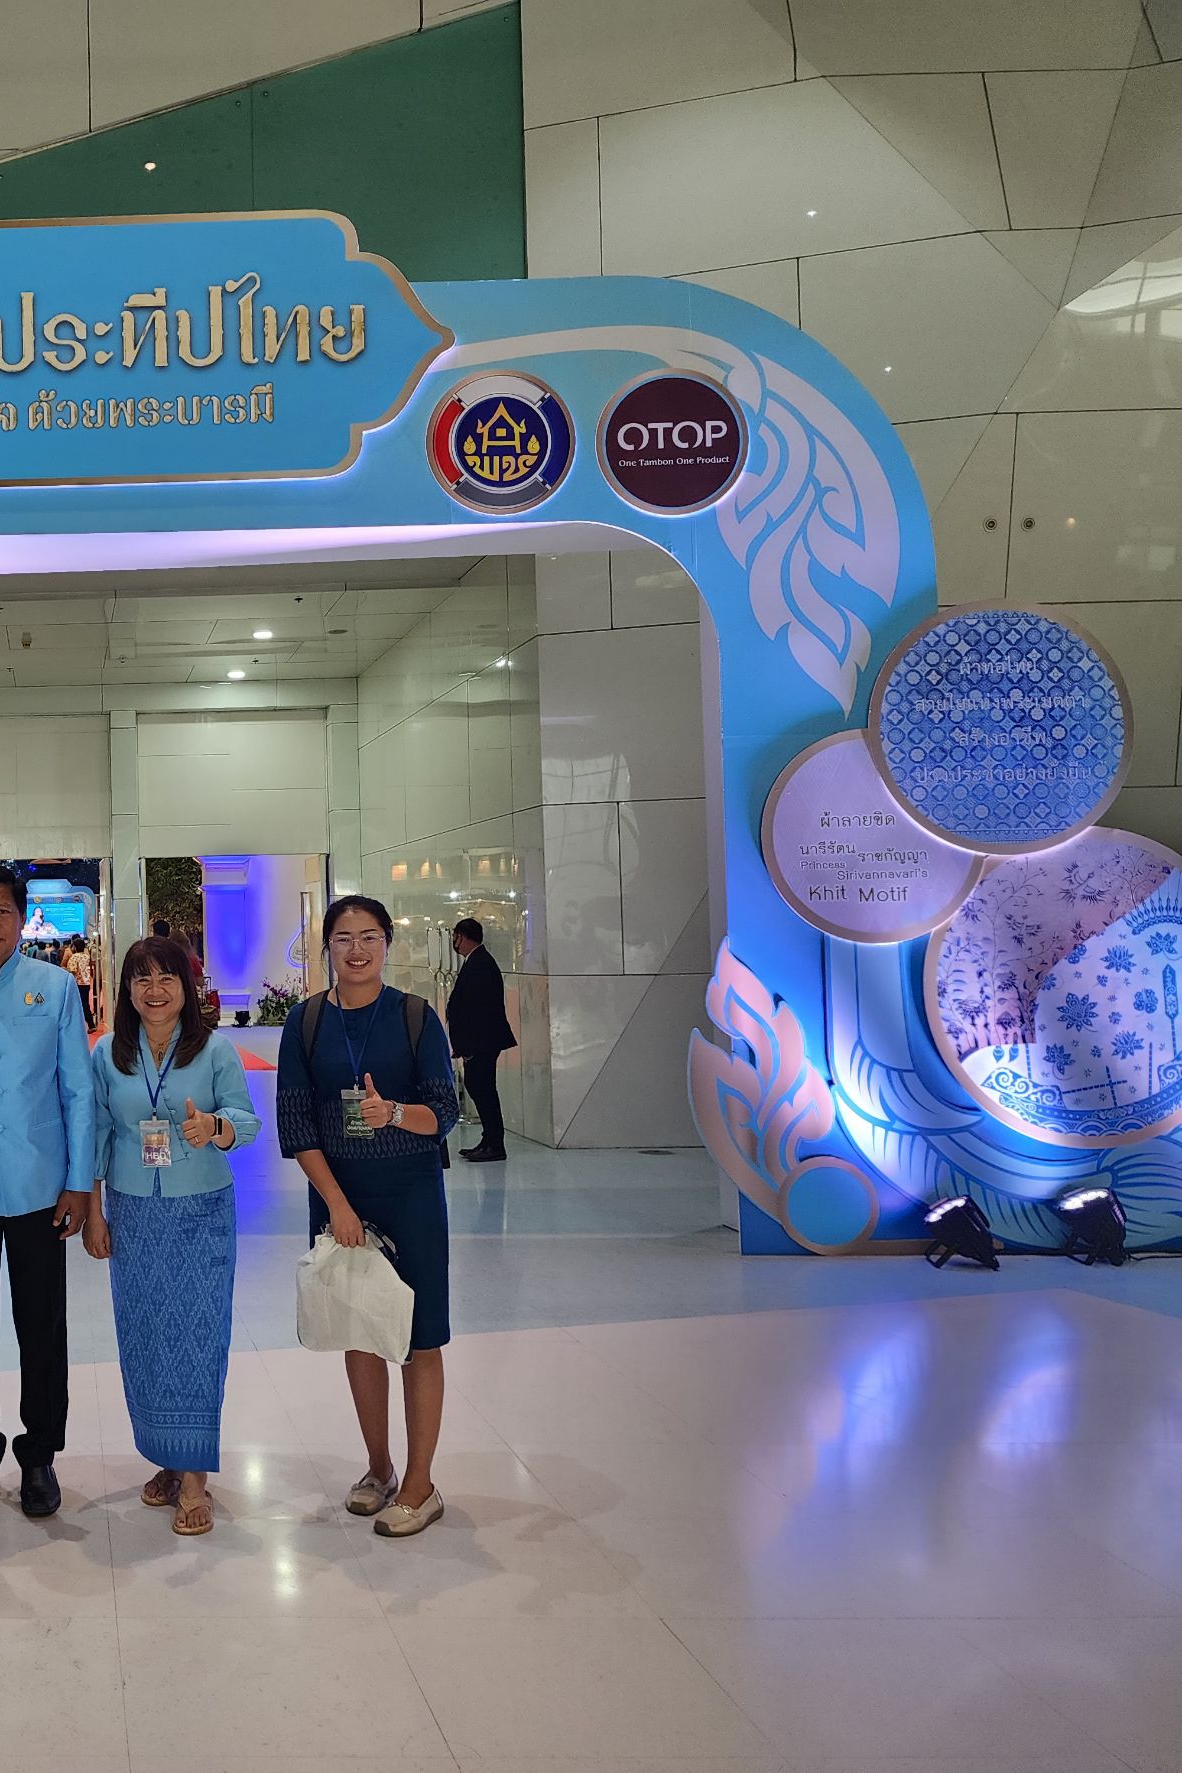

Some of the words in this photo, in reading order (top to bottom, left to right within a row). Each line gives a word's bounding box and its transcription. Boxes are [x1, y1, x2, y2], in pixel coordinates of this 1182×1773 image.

[28, 382, 274, 431] ด้วยพระบารมี
[617, 420, 728, 451] OTOP
[618, 459, 637, 467] One
[639, 457, 674, 467] Tambon
[676, 457, 695, 465] One
[696, 455, 730, 464] Product
[820, 810, 896, 828] ผ้าลายขิด
[799, 841, 856, 855] นารีรัตน
[857, 848, 928, 864] ราชกัญญา
[800, 860, 846, 870] Princess
[836, 868, 929, 881] Sirivannavari's
[809, 885, 848, 901] Khit
[859, 886, 909, 902] Motif
